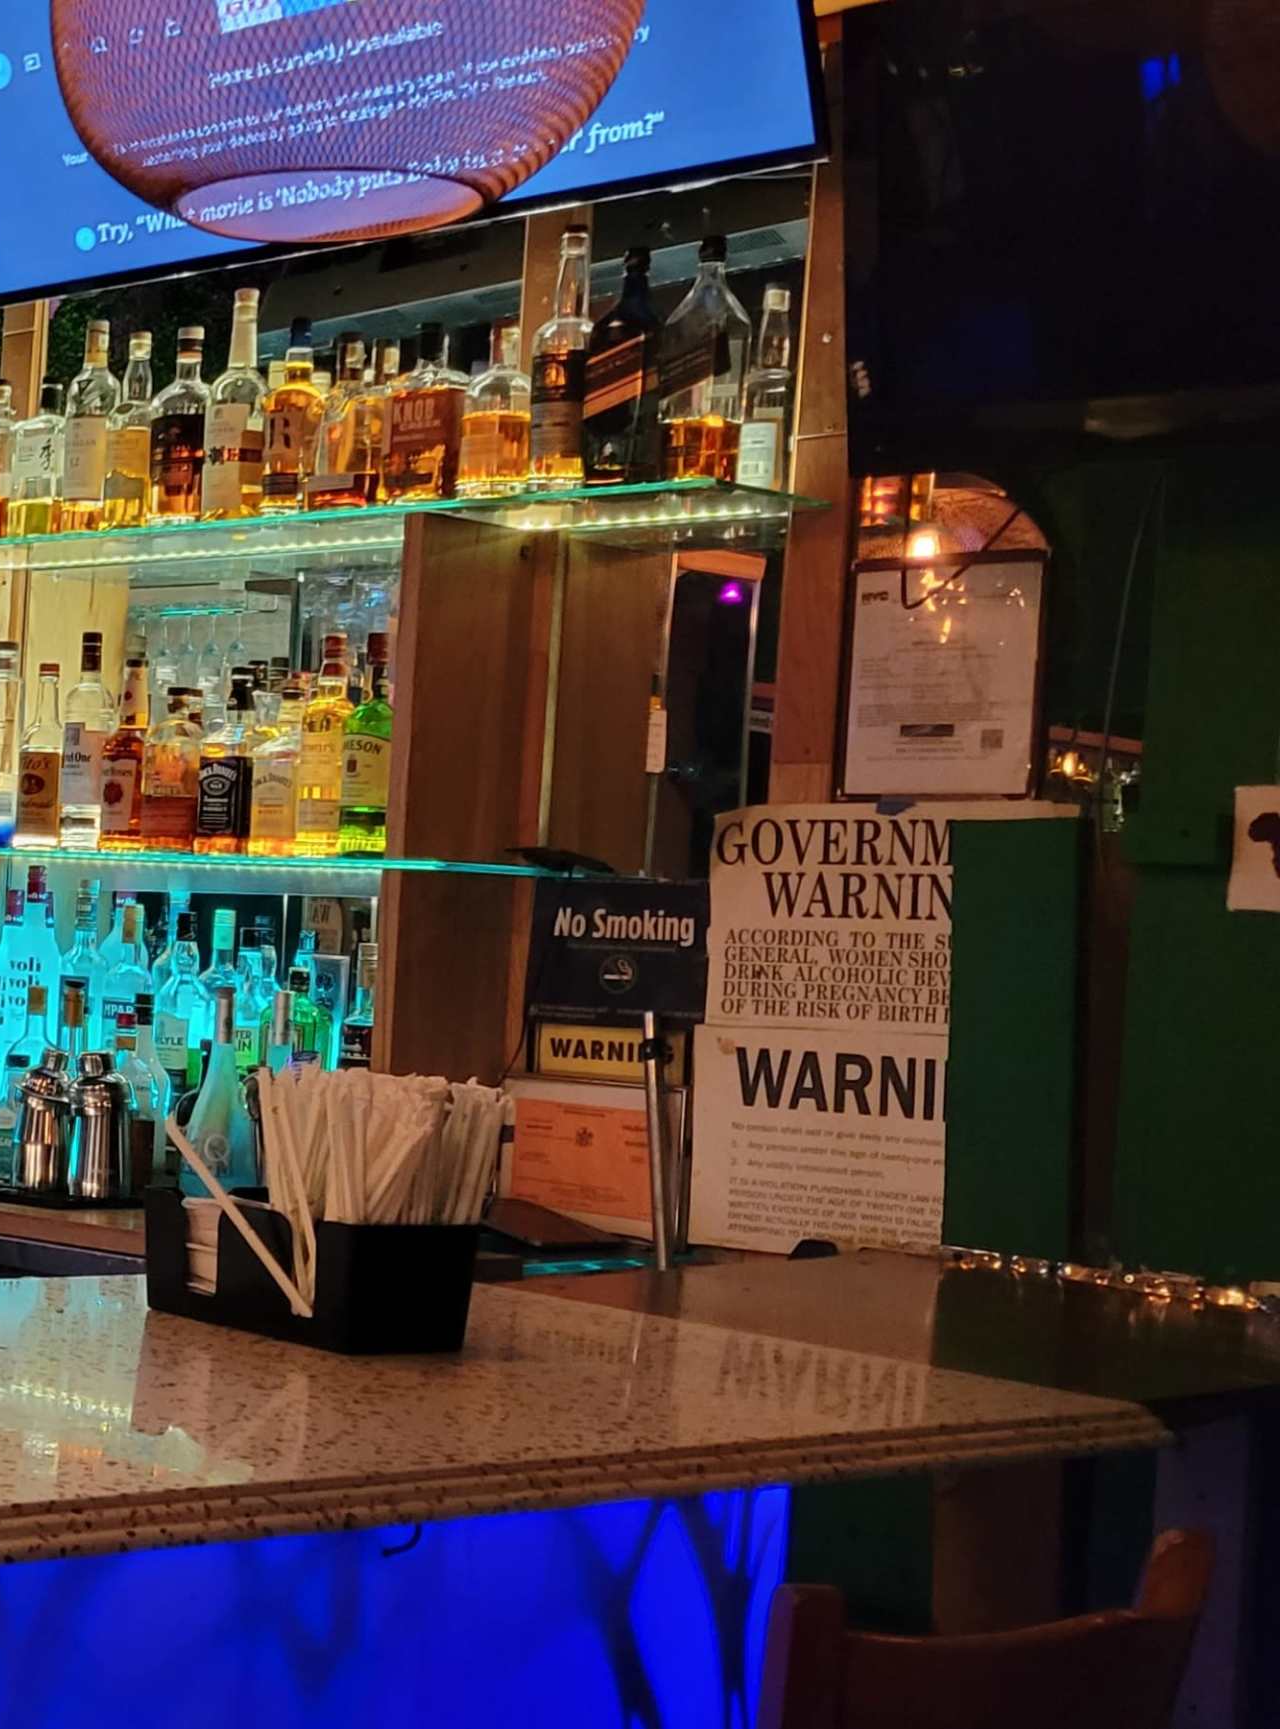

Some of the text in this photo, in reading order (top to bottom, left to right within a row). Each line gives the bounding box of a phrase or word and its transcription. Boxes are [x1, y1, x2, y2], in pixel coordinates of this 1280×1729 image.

[98, 219, 134, 246] Try,
[199, 195, 253, 223] movie
[256, 191, 273, 210] is
[356, 168, 404, 196] puts
[393, 398, 435, 424] KNOB
[761, 871, 952, 920] WARNIN
[553, 907, 695, 947] No Smoking
[724, 929, 839, 948] ACCORDING
[850, 931, 875, 948] TO
[886, 932, 925, 949] THE
[829, 949, 903, 968] WOMEN
[908, 952, 948, 969] SHO
[724, 963, 783, 981] DRINK
[793, 965, 908, 986] ALCOHOLIC
[722, 981, 797, 998] DURING
[804, 983, 922, 1005] PREGNANCY
[721, 999, 942, 1024] OF THE RISK OF BIRTH
[550, 1037, 674, 1066] WARNI
[735, 1046, 948, 1121] WARNI
